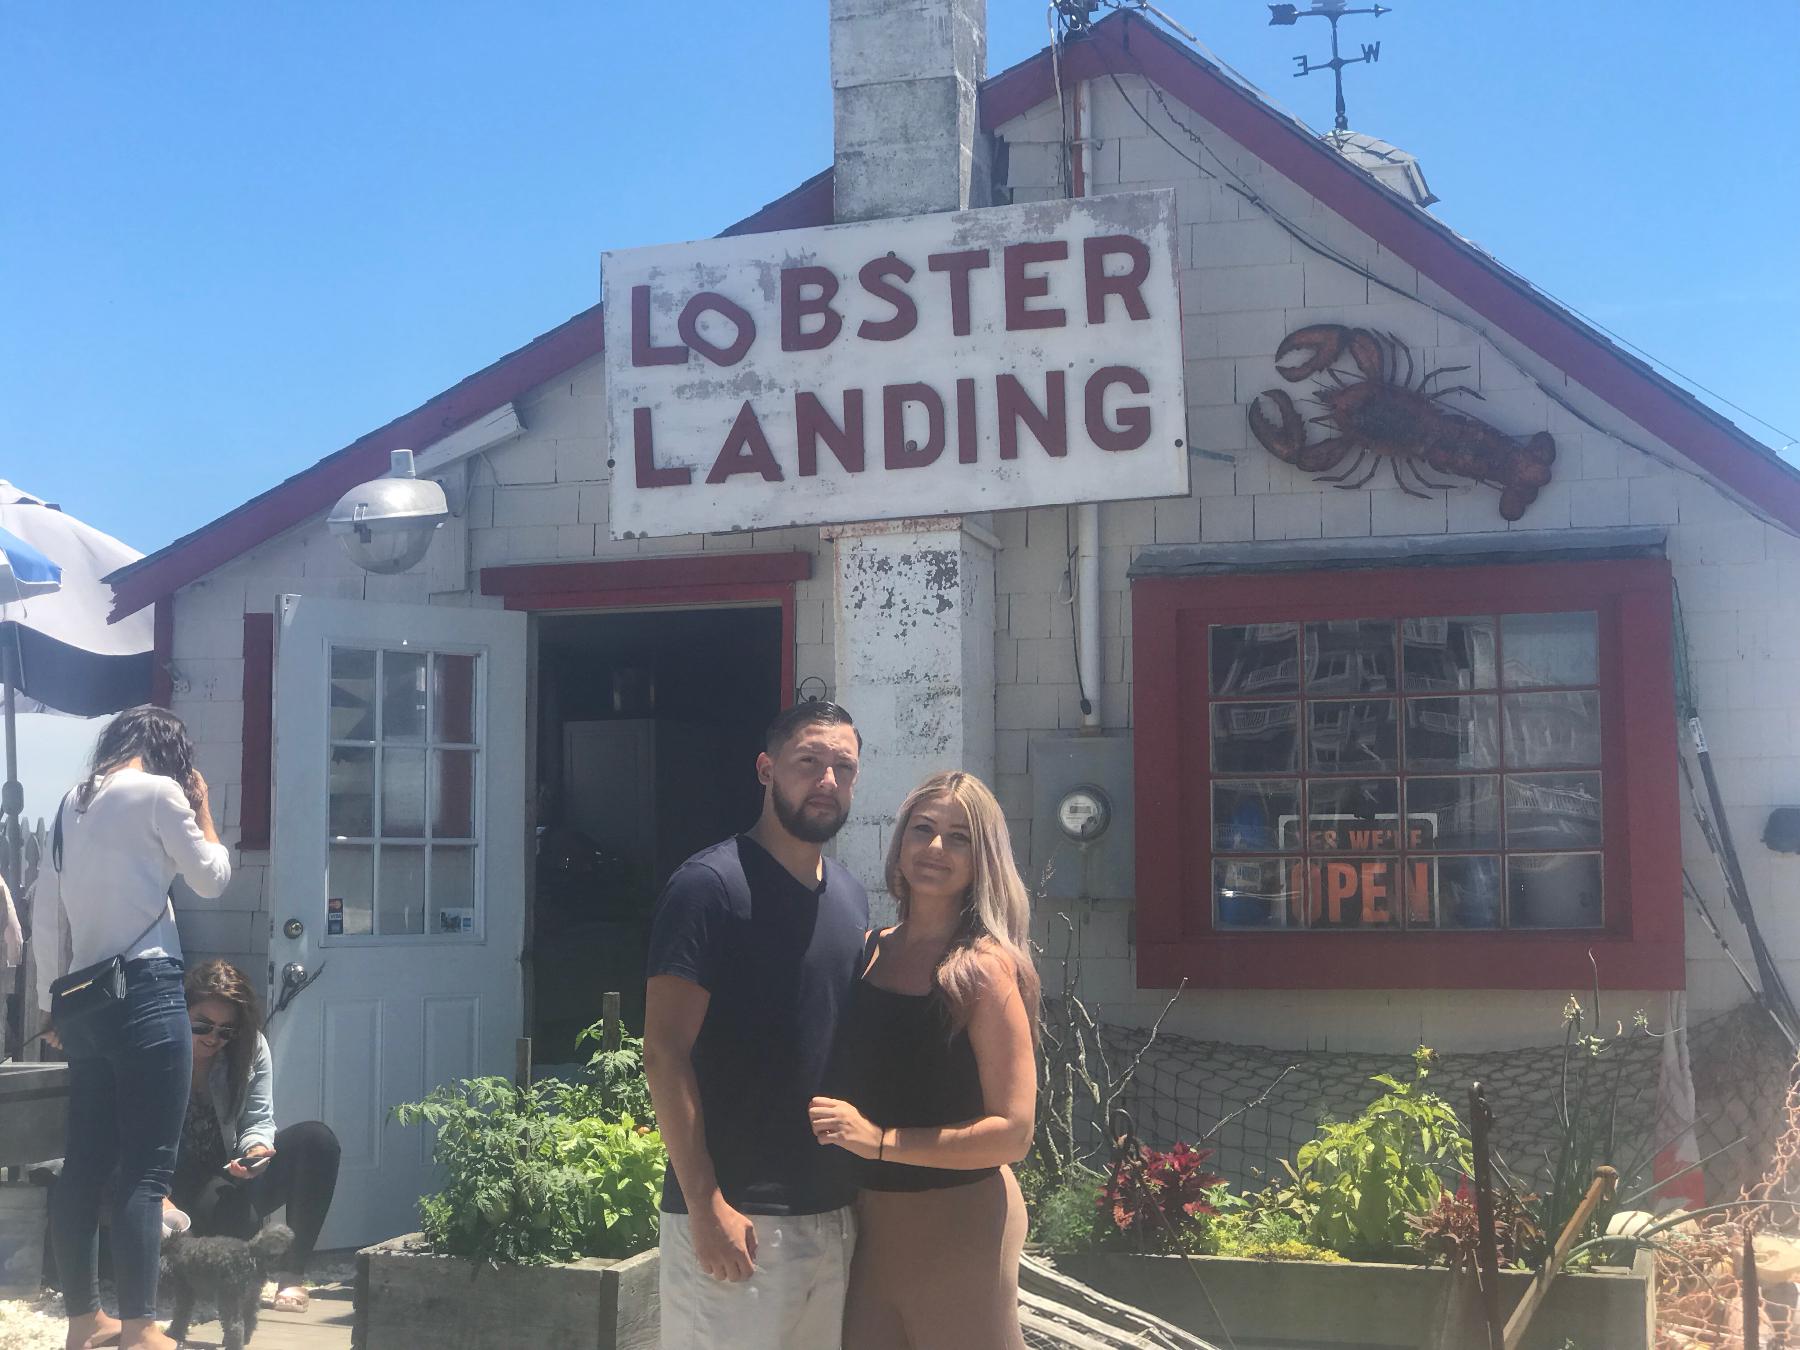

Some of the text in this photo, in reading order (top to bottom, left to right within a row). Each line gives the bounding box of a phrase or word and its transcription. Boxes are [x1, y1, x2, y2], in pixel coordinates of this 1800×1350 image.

[1361, 41, 1381, 63] W
[631, 234, 1152, 367] LOBSTER
[632, 365, 1152, 489] LANDING
[1291, 862, 1430, 922] OPEN
